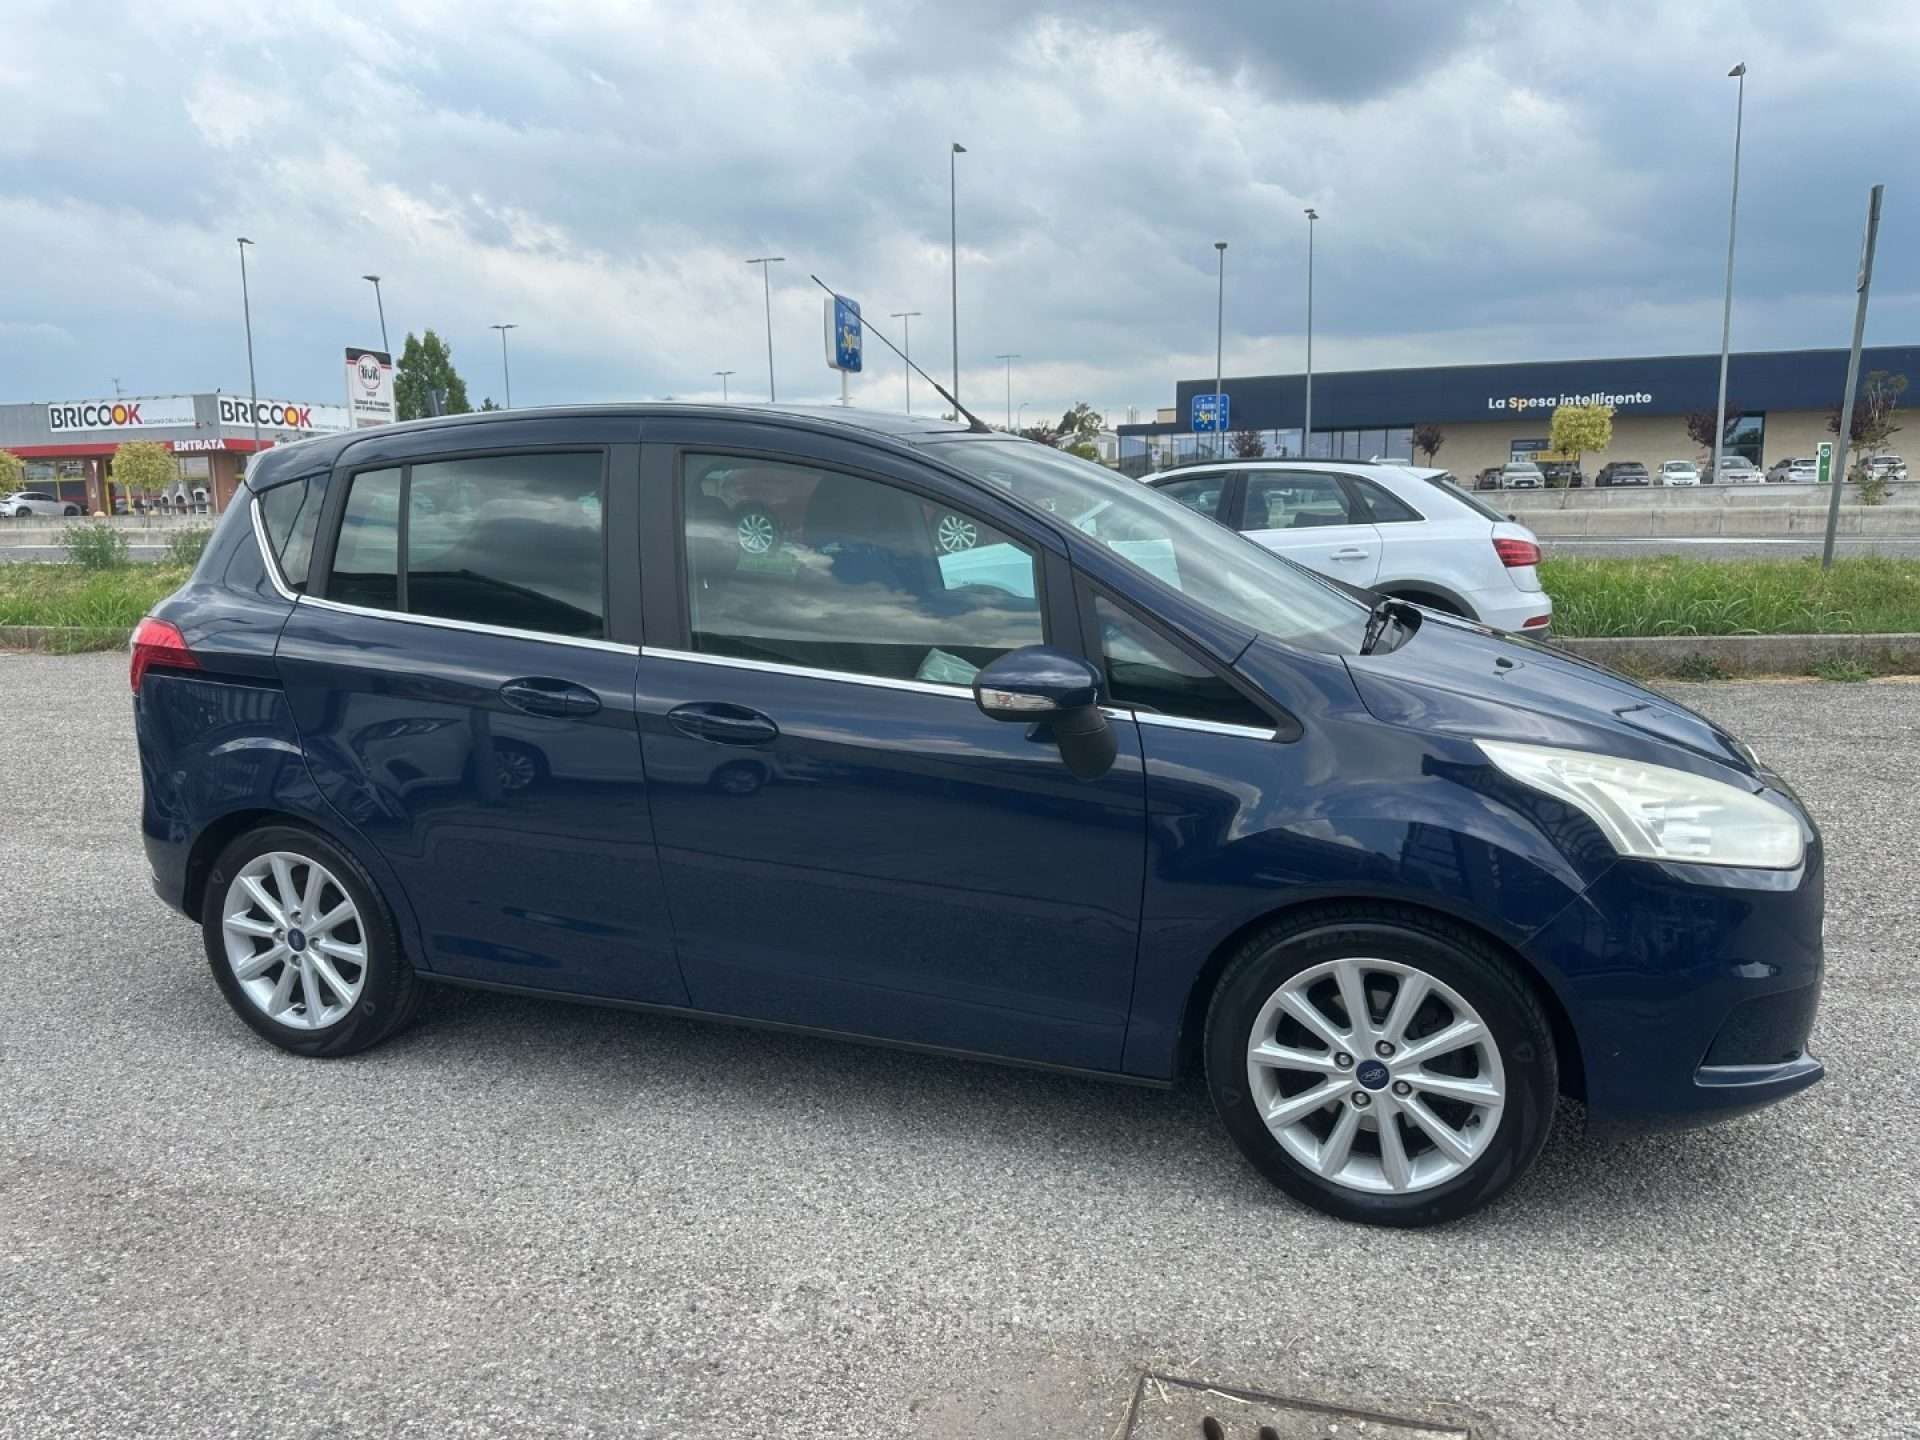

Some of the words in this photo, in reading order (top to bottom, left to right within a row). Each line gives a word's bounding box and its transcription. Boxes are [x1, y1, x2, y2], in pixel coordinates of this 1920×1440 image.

[1488, 398, 1505, 409] La
[1509, 396, 1556, 412] Spesa
[1560, 391, 1652, 408] intelligente
[174, 439, 225, 451] ENTRATA
